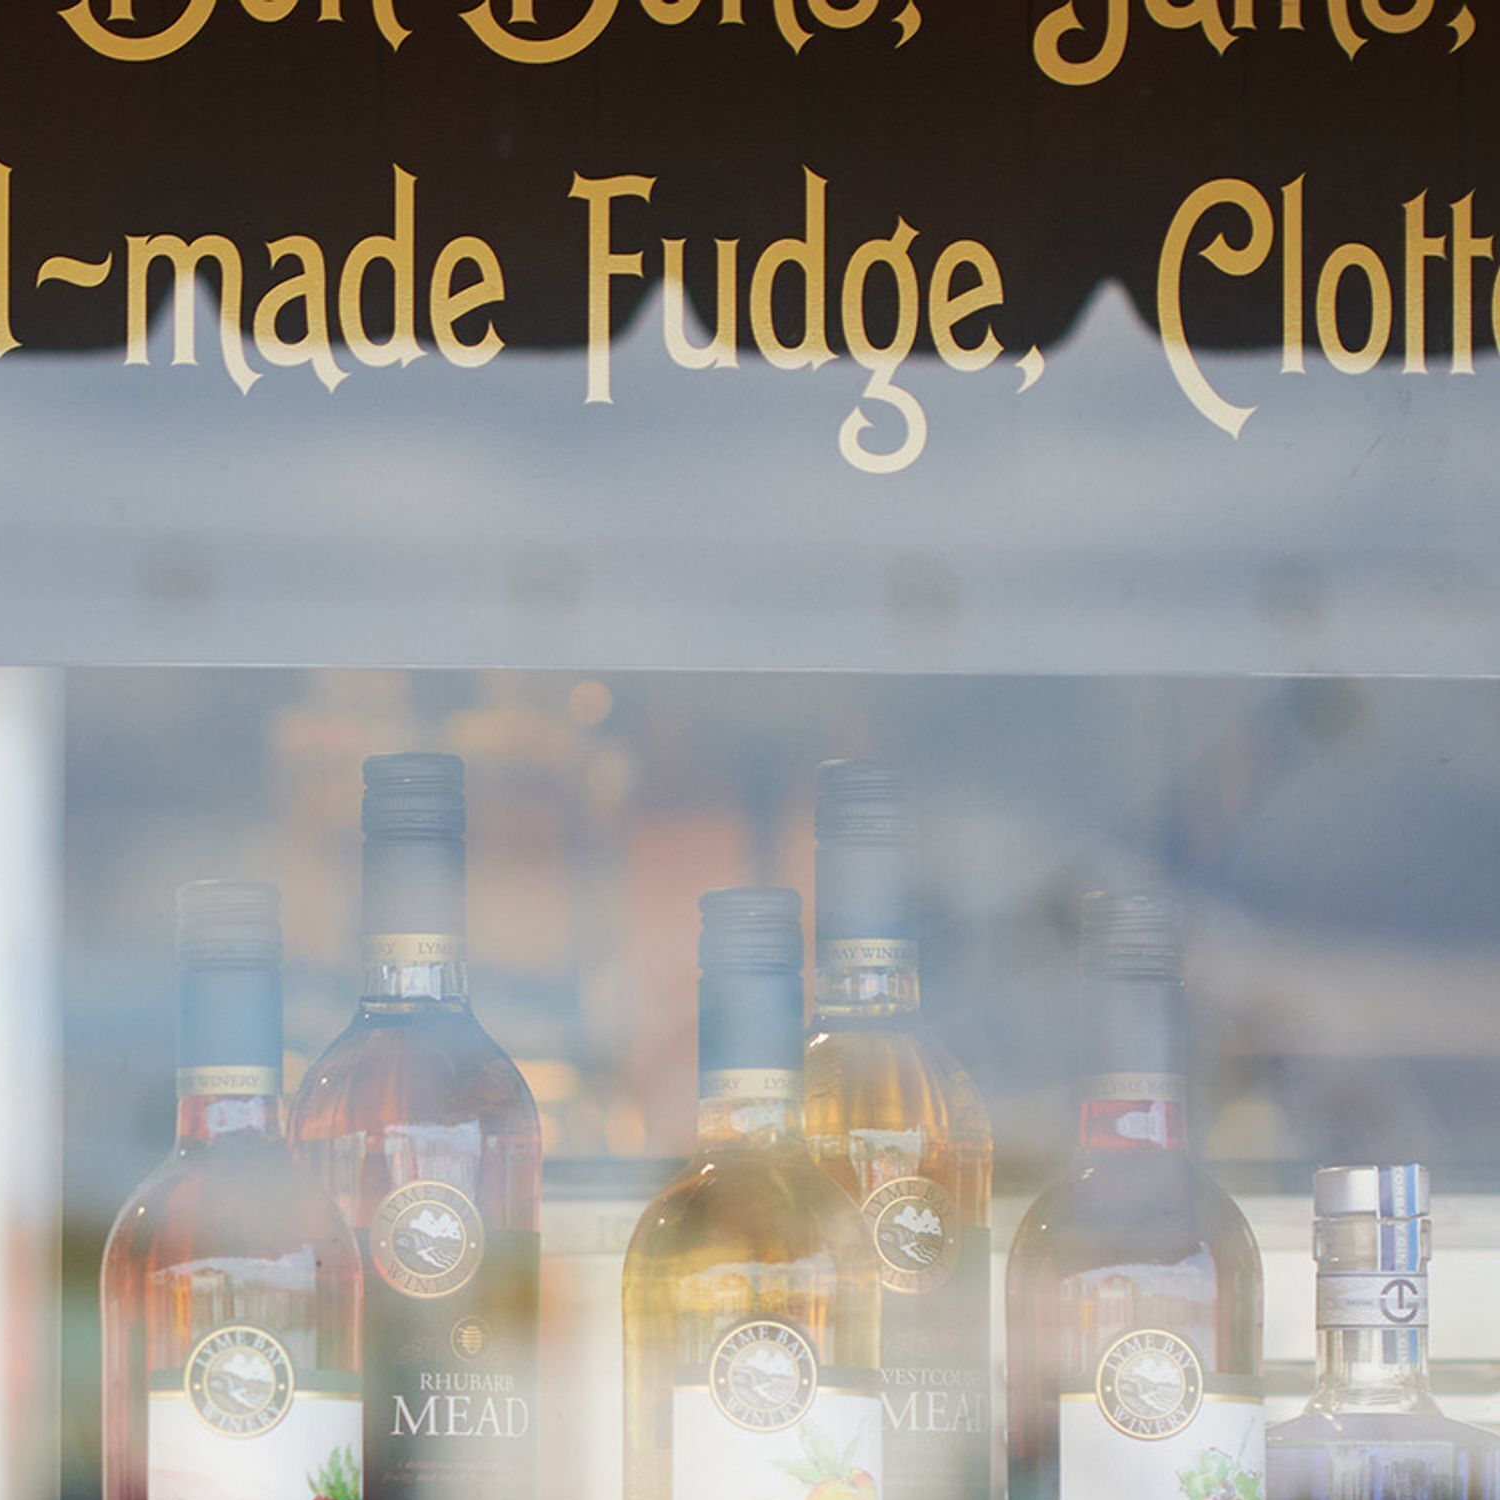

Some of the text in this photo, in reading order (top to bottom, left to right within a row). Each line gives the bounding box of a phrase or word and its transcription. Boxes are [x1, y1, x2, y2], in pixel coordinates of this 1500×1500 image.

[568, 165, 1045, 474] Fudge,
[1157, 172, 1500, 440] Clott
[196, 1330, 284, 1367] LYME BAY
[718, 1326, 808, 1363] LYME BAY
[1106, 1334, 1195, 1370] LYME BAY
[420, 1372, 515, 1392] RHUBARB
[390, 1394, 530, 1438] MEAD
[1112, 1404, 1192, 1435] WINERY
